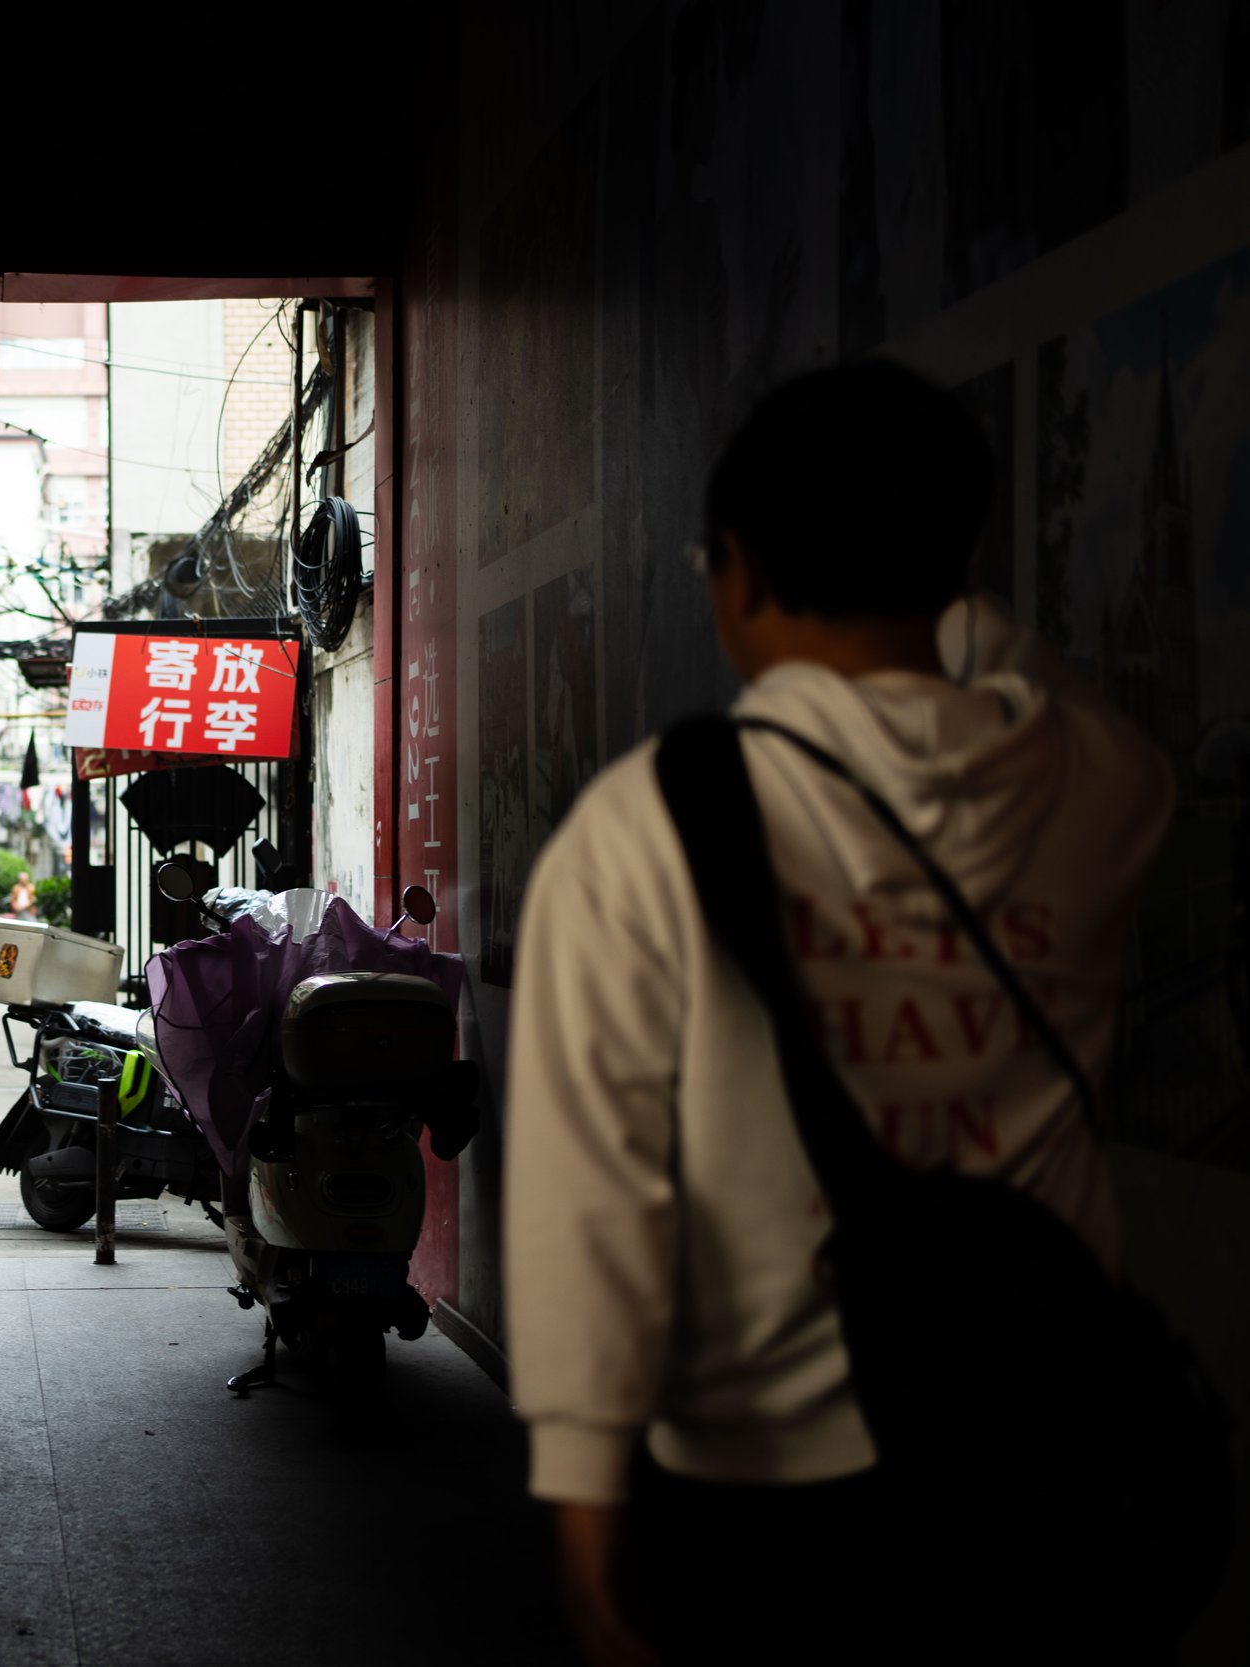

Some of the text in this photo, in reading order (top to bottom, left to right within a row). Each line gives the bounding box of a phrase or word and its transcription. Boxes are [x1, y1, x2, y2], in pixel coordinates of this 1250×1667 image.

[407, 338, 421, 831] SINCE 1921
[145, 640, 265, 693] 寄放
[138, 697, 258, 751] 行李
[872, 1095, 1000, 1164] UN
